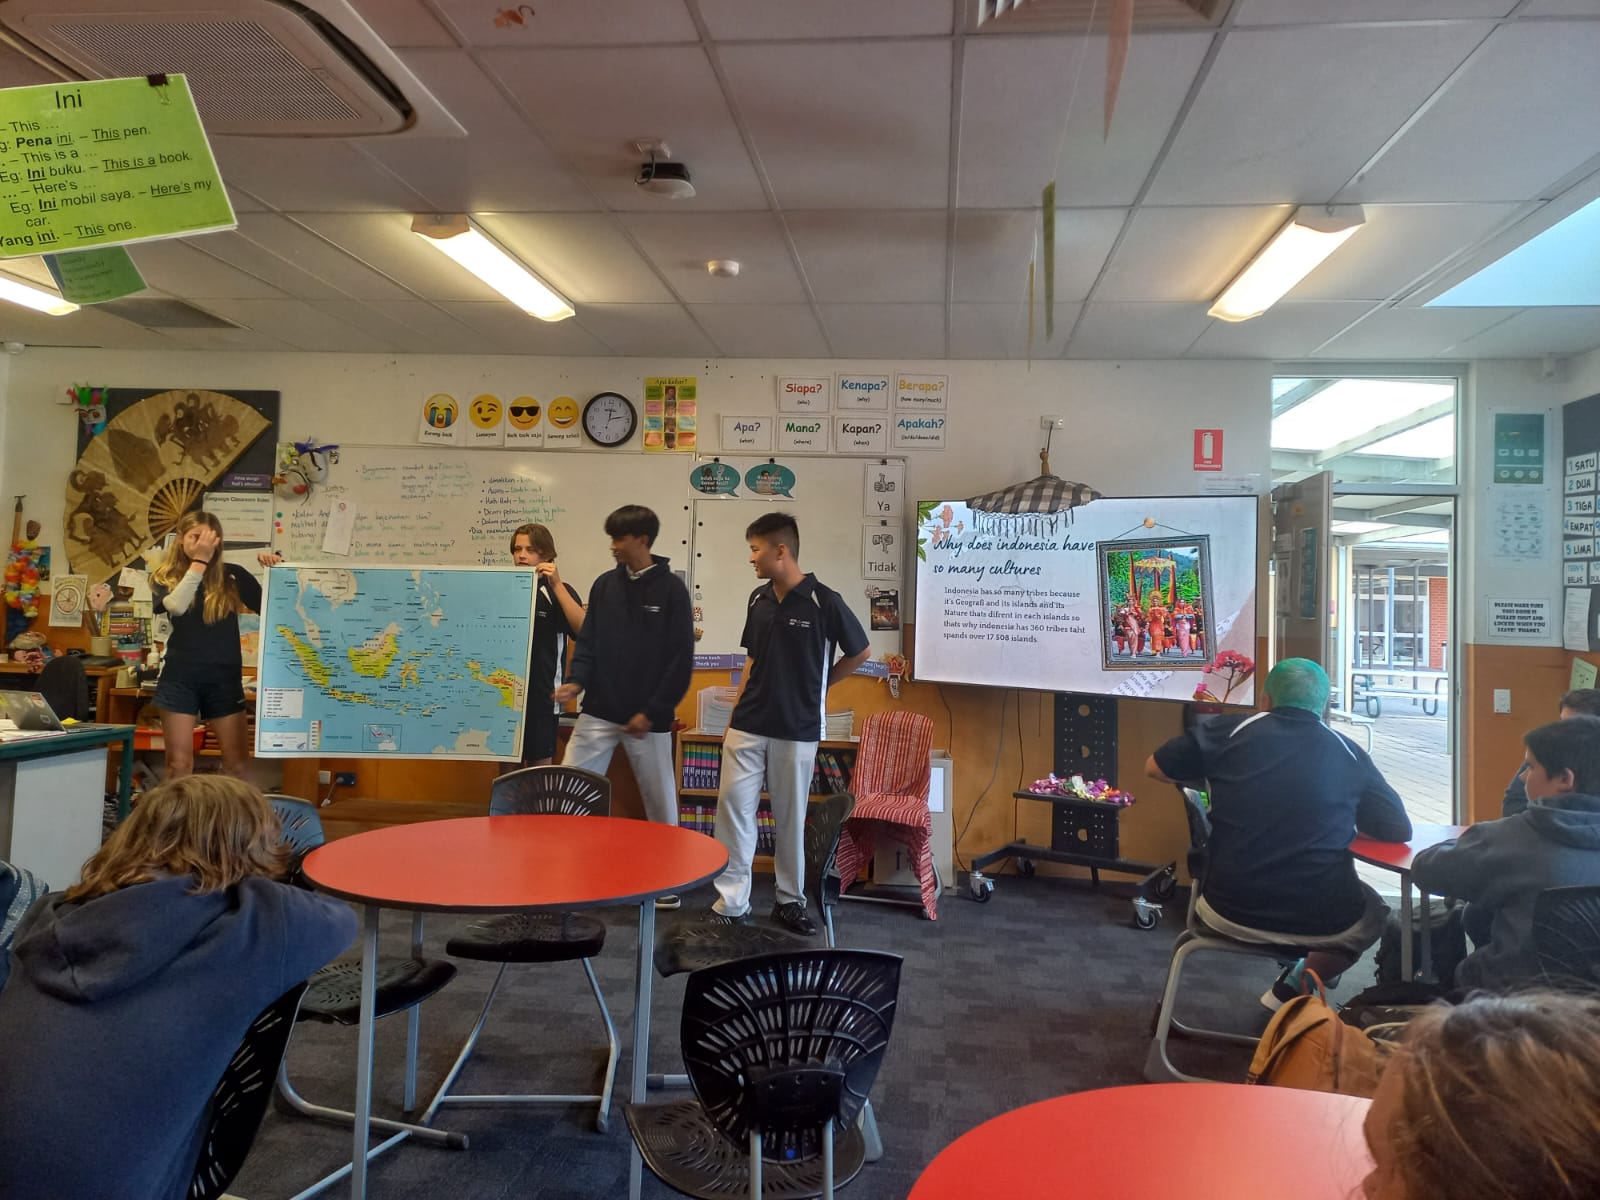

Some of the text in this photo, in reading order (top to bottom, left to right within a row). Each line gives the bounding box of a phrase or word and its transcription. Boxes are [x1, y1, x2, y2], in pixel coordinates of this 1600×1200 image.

[55, 89, 82, 109] Ini
[9, 121, 40, 133] This
[0, 141, 11, 153] g:
[16, 136, 53, 148] Pena
[92, 129, 120, 141] This
[123, 126, 151, 139] pen.
[22, 150, 79, 164] This is a
[27, 167, 47, 180] Ini
[49, 164, 86, 177] buku.
[102, 159, 130, 171] This
[133, 157, 144, 167] is
[148, 156, 156, 165] a
[159, 151, 193, 164] book.
[33, 180, 78, 195] Here's
[10, 180, 212, 215] Eg: Ini mobil saya. Here's my
[26, 217, 51, 227] car.
[36, 230, 60, 244] ini.
[74, 224, 105, 238] This
[107, 220, 137, 232] one.
[785, 383, 823, 396] Siapa?
[841, 380, 887, 393] Kenapa?
[898, 380, 945, 391] Berapa?
[734, 422, 761, 433] Apa?
[785, 423, 821, 433] Mana?
[842, 423, 882, 436] Kapan?
[897, 418, 944, 430] Apakah?
[1569, 458, 1595, 471] 1 SATU
[1568, 479, 1591, 490] 2 DUA
[877, 501, 890, 512] Ya
[1568, 501, 1573, 511] 3
[1575, 501, 1592, 511] TIGA
[1570, 522, 1594, 532] EMPAT
[934, 534, 1095, 558] Why does indonesia have
[1566, 544, 1591, 555] 5 LIMA
[868, 562, 896, 572] Tidak
[933, 559, 1042, 582] so many cultures
[944, 587, 979, 595] Indonesia
[980, 587, 993, 595] has
[1003, 590, 1025, 598] many
[1026, 589, 1048, 597] tribes
[1049, 589, 1080, 597] because
[1012, 600, 1038, 608] islands
[988, 610, 1013, 619] difrent
[1024, 612, 1041, 620] each
[1043, 613, 1070, 621] islands
[944, 620, 960, 628] thats
[962, 621, 978, 630] why
[979, 622, 1014, 630] indonesia
[944, 632, 968, 640] spands
